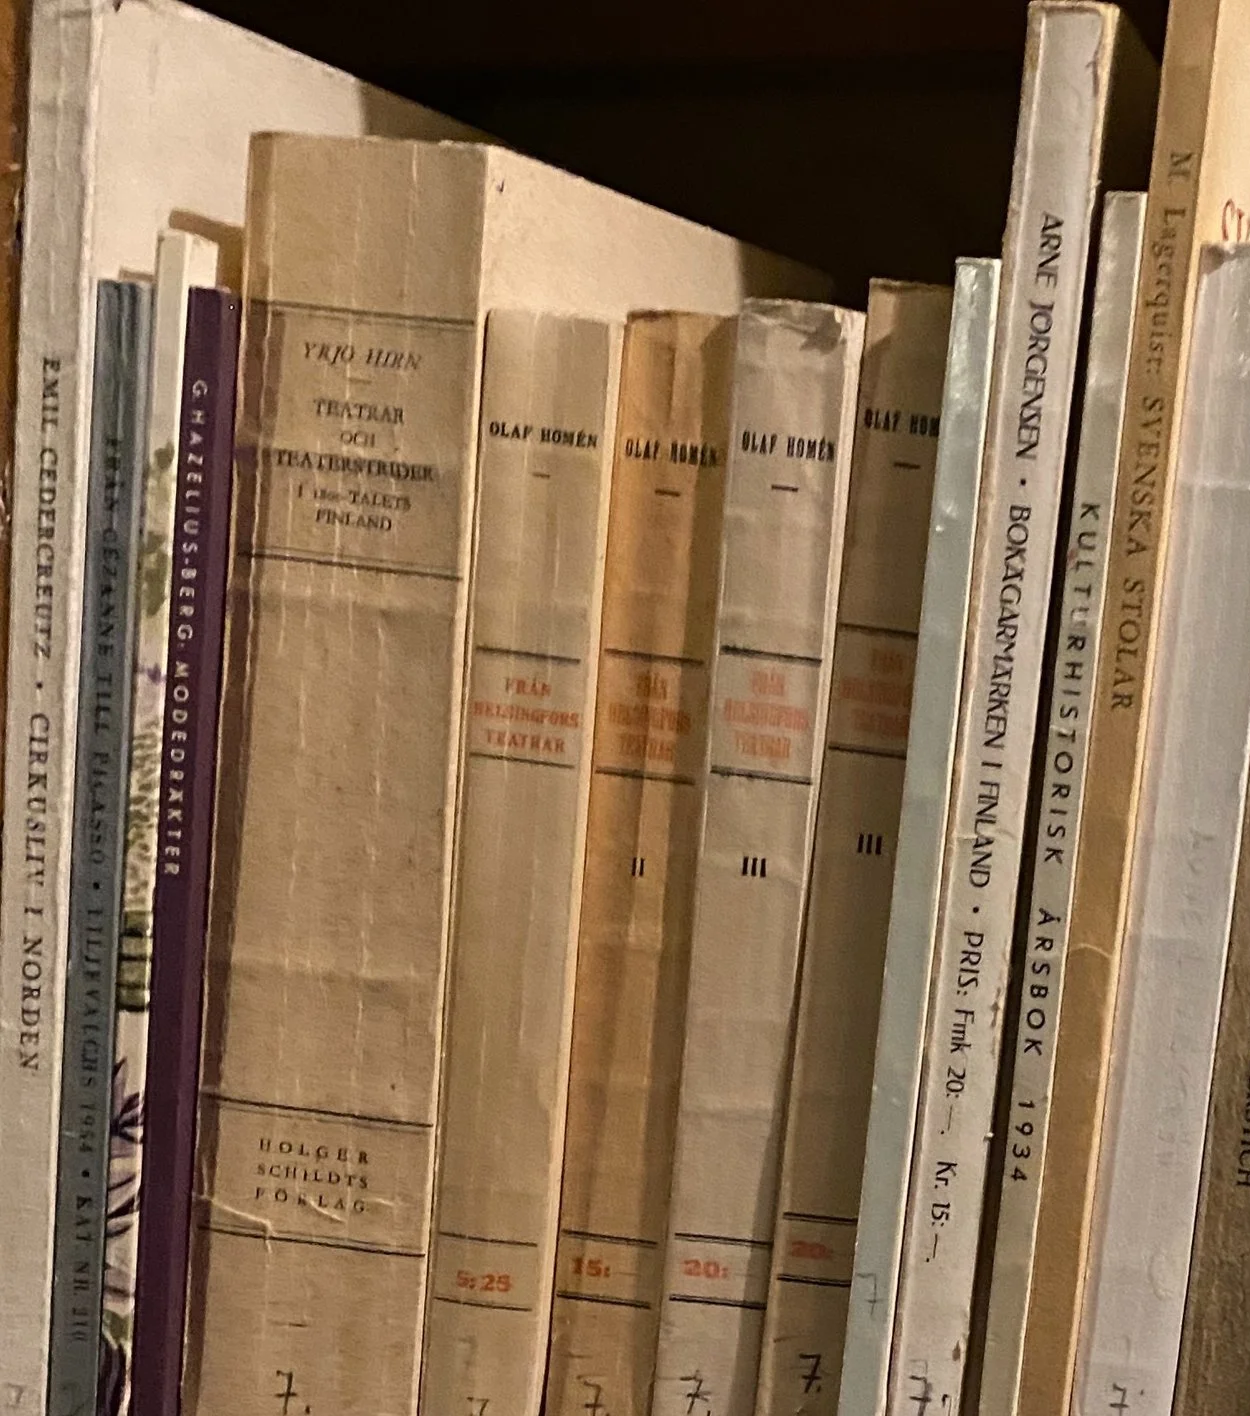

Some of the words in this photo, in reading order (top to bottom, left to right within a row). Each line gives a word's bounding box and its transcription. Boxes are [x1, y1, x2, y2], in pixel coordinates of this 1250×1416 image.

[1034, 211, 1064, 288] ARNE
[41, 358, 60, 427] EMIL
[313, 398, 405, 426] TEATRAR
[864, 407, 899, 432] OLAF
[340, 431, 376, 448] OCH
[489, 421, 533, 442] OLAF
[539, 428, 598, 450] HOMÉN
[625, 438, 660, 460] OLAF
[741, 429, 778, 454] OLAF
[786, 435, 836, 463] HOMÉN
[274, 449, 435, 483] TEATERSTRIDER
[1126, 398, 1164, 557] SVENSKA
[315, 509, 393, 531] FINLAND
[33, 449, 57, 660] CEDERCREUTZ
[1111, 581, 1147, 711] STOLAR
[504, 675, 552, 699] FRÅN
[1043, 502, 1101, 865] KULTURHISTORISK
[472, 699, 580, 730] HELSINGFORS
[485, 730, 566, 755] TEATRAR
[25, 712, 50, 888] CIRKUSLIV
[857, 833, 883, 856] III
[968, 774, 1000, 889] FINLAND
[631, 857, 646, 877] II
[742, 855, 767, 879] III
[955, 930, 985, 997] PRIS:
[1023, 907, 1061, 1056] ÅRSBOK
[19, 935, 42, 1070] NORDEN
[258, 1137, 370, 1165] HOLGER
[1010, 1100, 1036, 1182] 1934
[256, 1161, 370, 1190] SCHILDTS
[934, 1161, 958, 1189] Kr.
[255, 1185, 368, 1214] FÖRLAG
